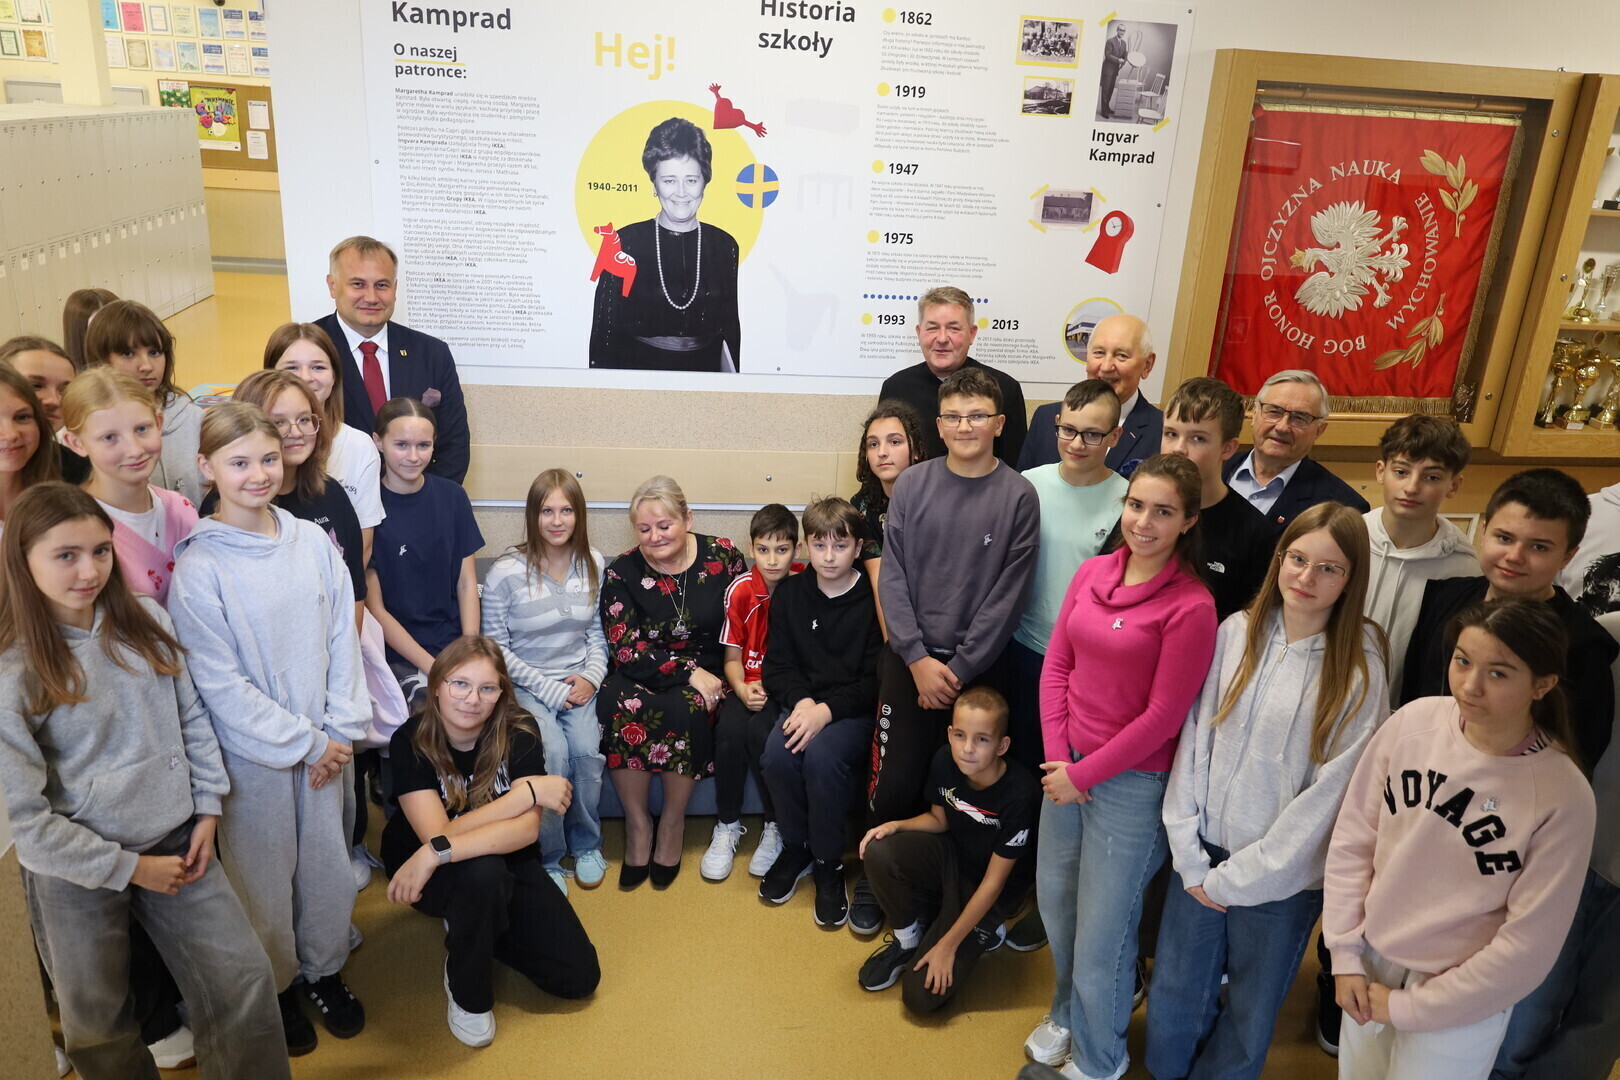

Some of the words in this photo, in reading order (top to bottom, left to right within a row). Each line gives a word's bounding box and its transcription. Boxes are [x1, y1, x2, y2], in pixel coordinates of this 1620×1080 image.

[392, 1, 512, 33] Kamprad
[760, 0, 855, 22] Historia
[900, 11, 932, 26] 1862
[394, 43, 405, 55] O
[410, 46, 457, 62] naszej
[758, 29, 834, 58] szkoły
[595, 32, 675, 80] Hej!
[395, 64, 467, 79] patronce:
[395, 87, 428, 96] Margaretha
[428, 89, 453, 97] Kamprad
[895, 85, 926, 99] 1919
[1092, 129, 1139, 145] Ingvar
[1089, 148, 1155, 166] Kamprad
[889, 163, 919, 176] 1947
[1329, 159, 1402, 185] NAUKA
[588, 182, 638, 193] 1940–2011
[1261, 177, 1323, 281] OJCZYZNA
[884, 232, 914, 245] 1975
[1385, 192, 1440, 331] WYCHOWANIE
[877, 314, 906, 326] 1993
[991, 319, 1020, 331] 2013
[1263, 290, 1315, 350] HONOR
[1323, 335, 1366, 357] BÓG
[1383, 769, 1522, 875] VOYAGE
